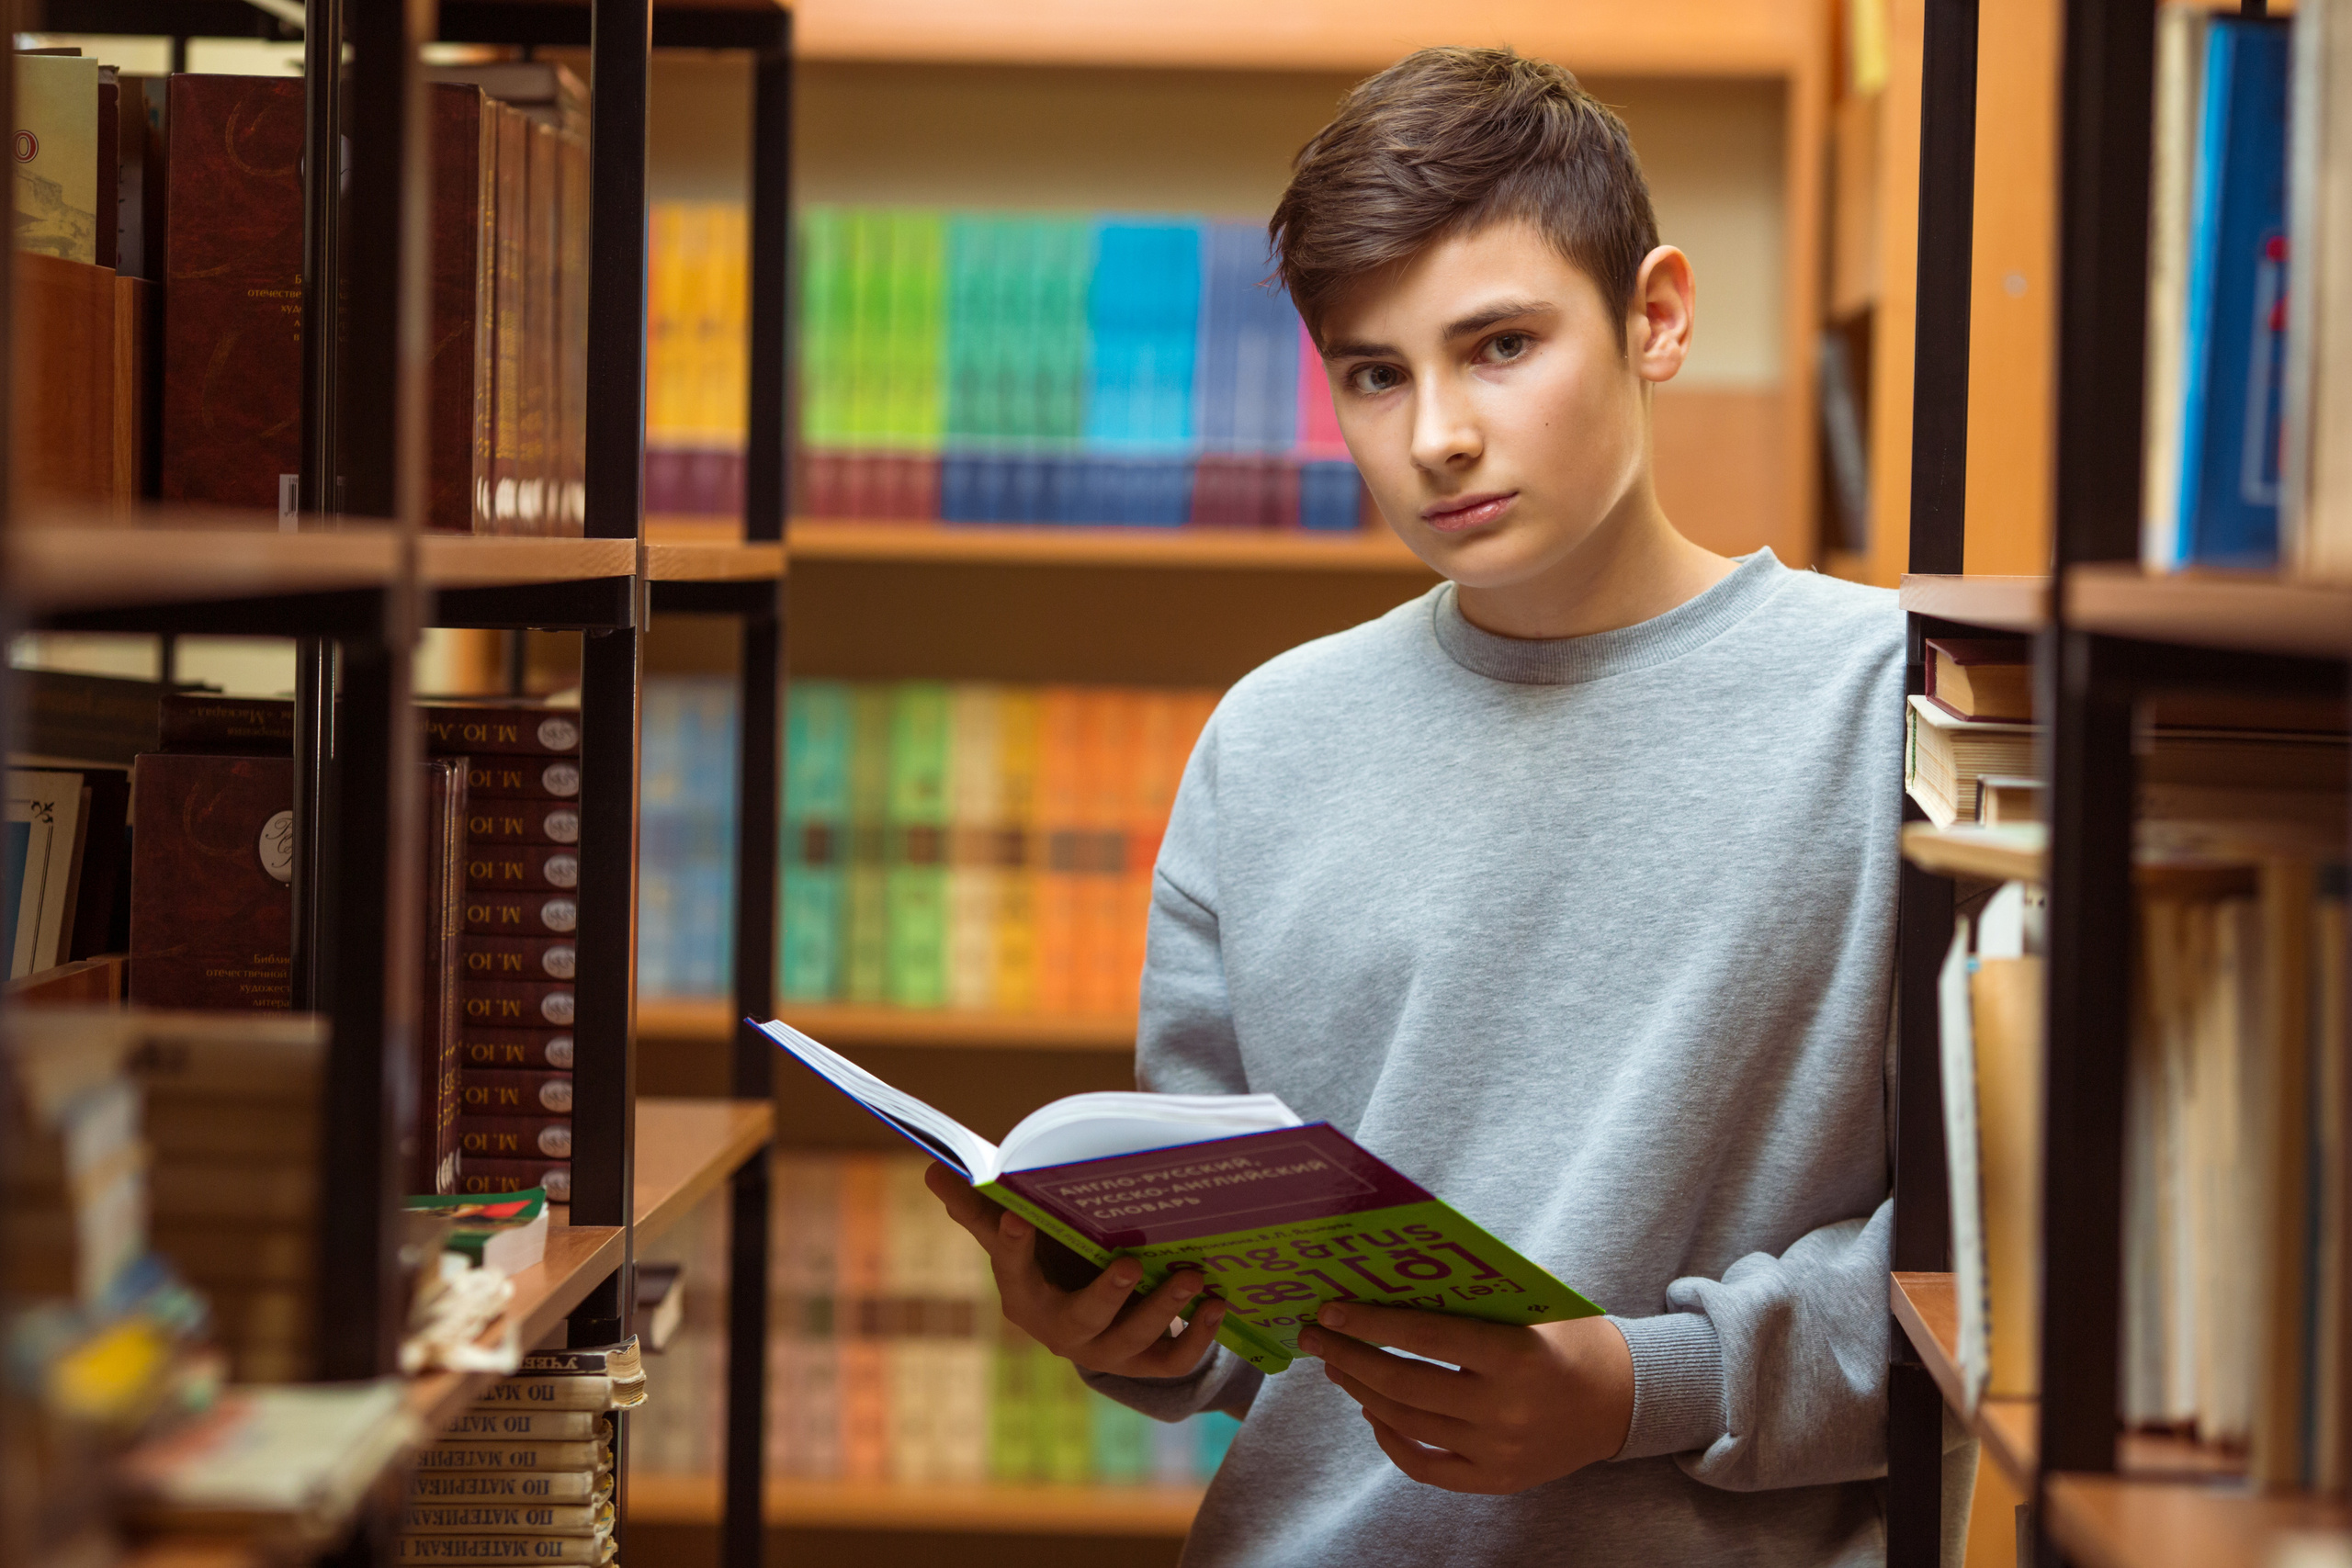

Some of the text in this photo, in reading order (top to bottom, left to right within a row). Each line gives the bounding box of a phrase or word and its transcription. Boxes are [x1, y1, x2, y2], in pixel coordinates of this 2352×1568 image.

[459, 722, 487, 742] Ю.
[493, 724, 517, 743] М.
[205, 968, 288, 979] отечественной
[1074, 1158, 1329, 1209] РУССКО-АНГЛИЙСКИЙ
[1093, 1196, 1202, 1219] СЛОВАРЬ
[520, 1356, 579, 1371] УЧЕБ
[527, 1384, 555, 1402] ПО
[505, 1416, 531, 1433] ПО
[510, 1450, 537, 1468] ПО
[412, 1479, 549, 1495] ПО МАТЕРИКА
[526, 1509, 554, 1526] ПО
[414, 1540, 527, 1558] МАТЕРИКАМ
[535, 1541, 563, 1558] ПО
